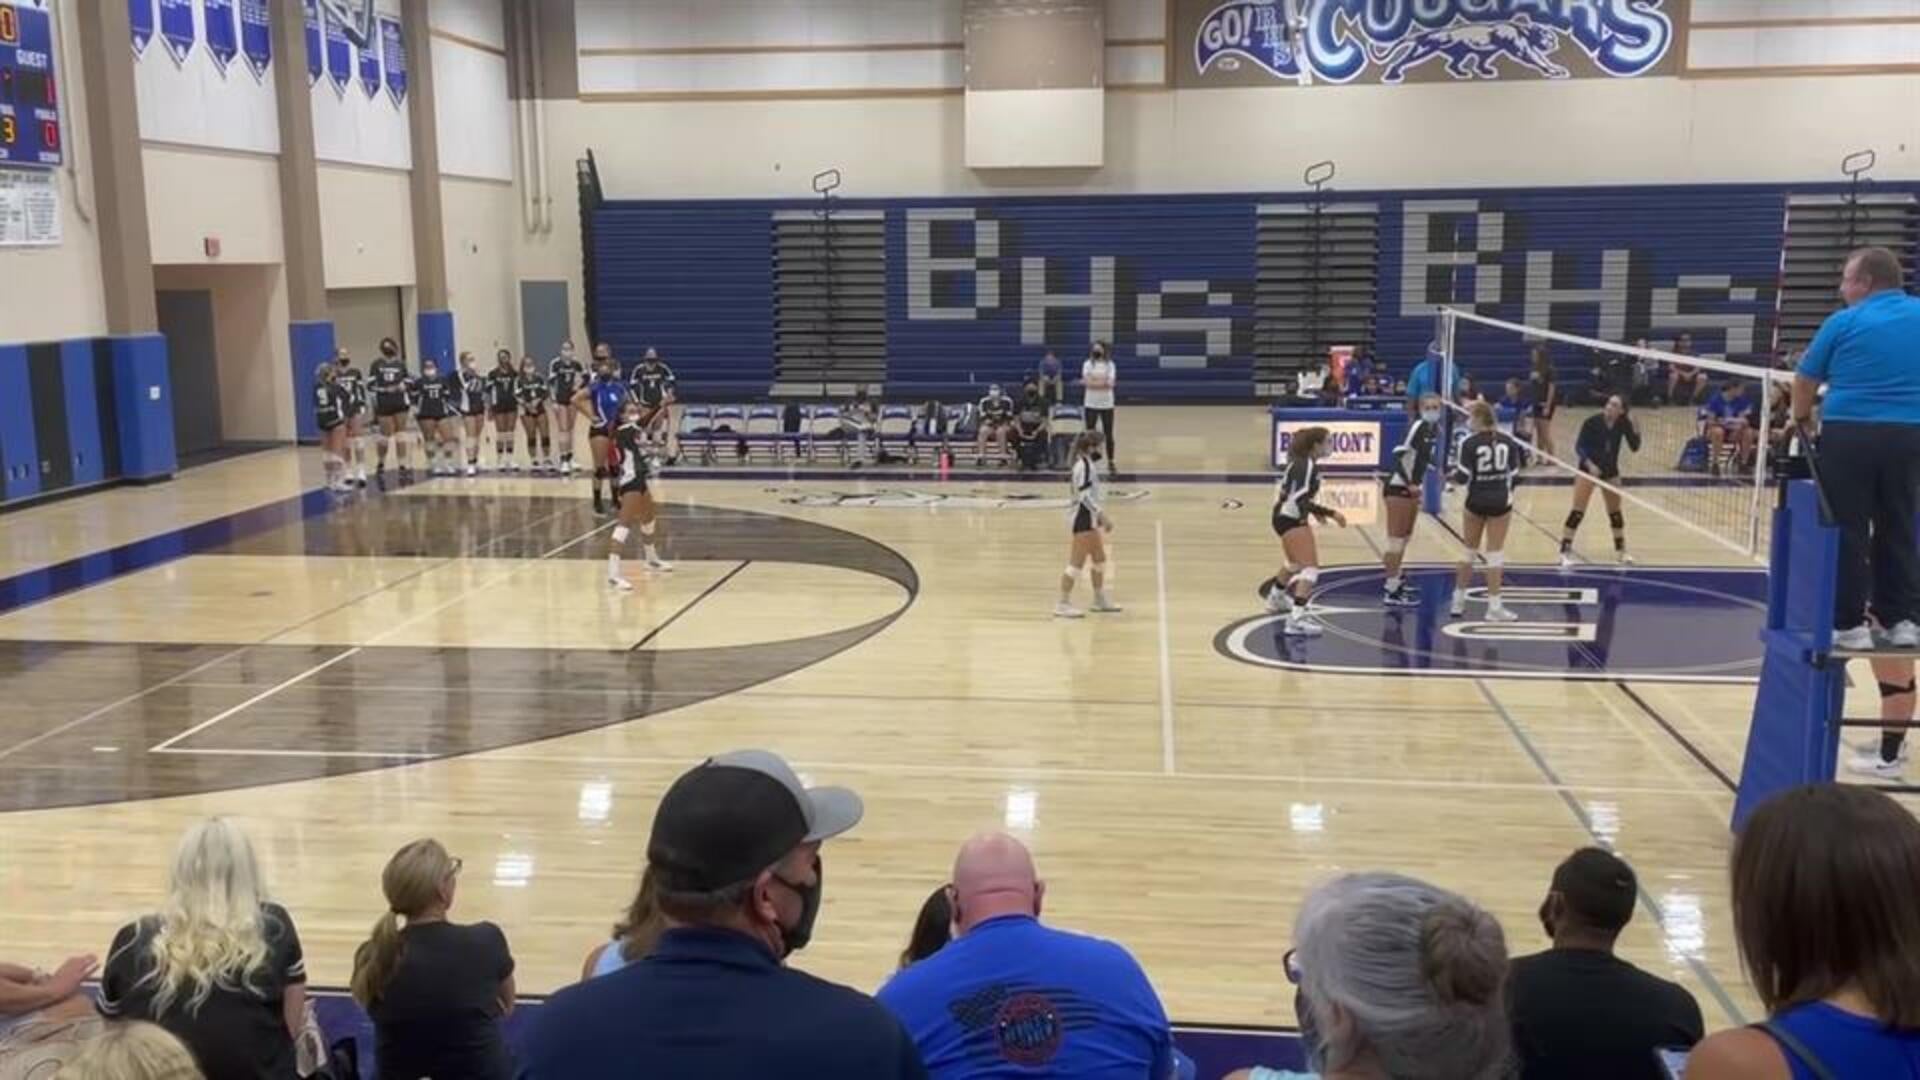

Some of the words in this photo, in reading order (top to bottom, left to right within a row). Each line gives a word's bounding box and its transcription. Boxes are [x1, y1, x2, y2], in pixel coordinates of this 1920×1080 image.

[1203, 5, 1253, 51] GO!
[16, 48, 48, 69] GUEST
[906, 207, 1233, 369] BHS
[1400, 199, 1758, 363] BHS
[1280, 431, 1374, 453] BMONT
[1476, 442, 1509, 473] 20
